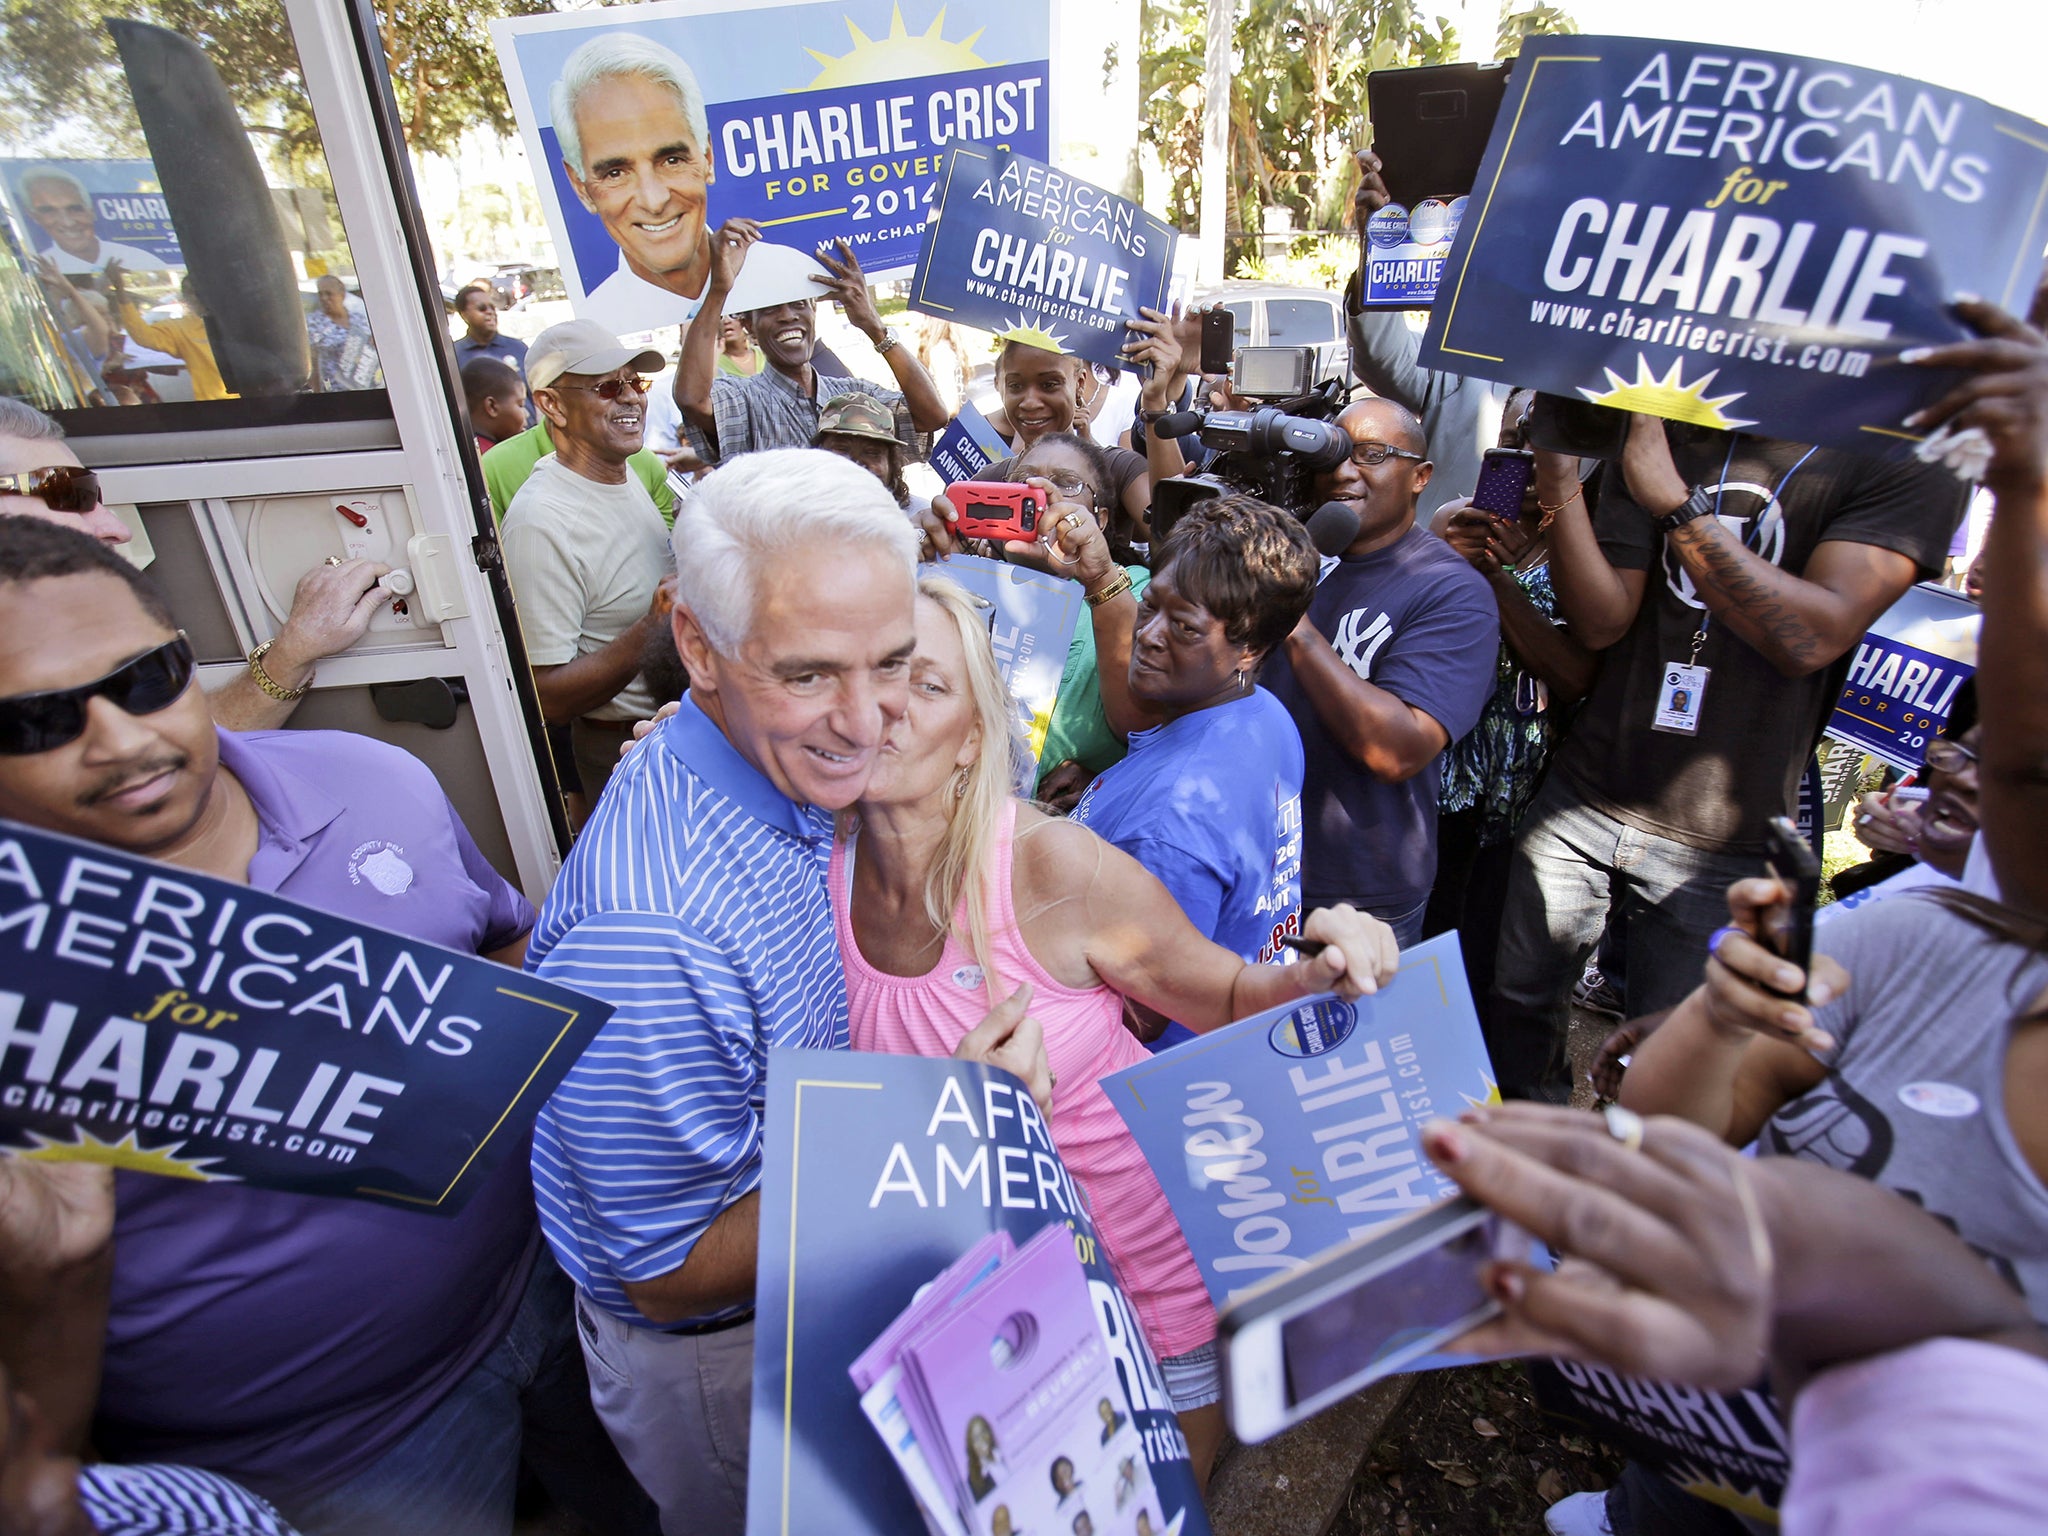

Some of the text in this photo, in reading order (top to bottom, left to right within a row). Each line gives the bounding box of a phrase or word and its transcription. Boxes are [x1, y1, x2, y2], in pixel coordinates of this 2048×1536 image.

[1622, 51, 1961, 145] AFRICAN
[721, 77, 1042, 178] CHARLIE CRIST
[1558, 99, 1990, 205] AMERICANS
[765, 173, 830, 201] FOR
[999, 160, 1135, 229] AFRICAN
[1704, 166, 1788, 209] for
[972, 178, 1148, 258] AMERICANS
[1042, 225, 1075, 246] for
[970, 227, 1130, 316] CHARLIE
[1372, 259, 1443, 284] CHARLIE
[1542, 197, 1928, 341] CHARLIE
[965, 278, 1117, 333] www.charliecrist.com
[1529, 298, 1874, 379] www.charliecrist.com
[1843, 689, 1888, 714] FOR
[351, 840, 382, 860] COUNTY
[0, 838, 453, 1004] AFRICAN
[132, 989, 239, 1032] for
[1298, 1004, 1316, 1025] CRIST
[1303, 1021, 1325, 1054] CHARLIE
[1287, 1039, 1431, 1241] ARLIE
[1290, 1165, 1335, 1208] for
